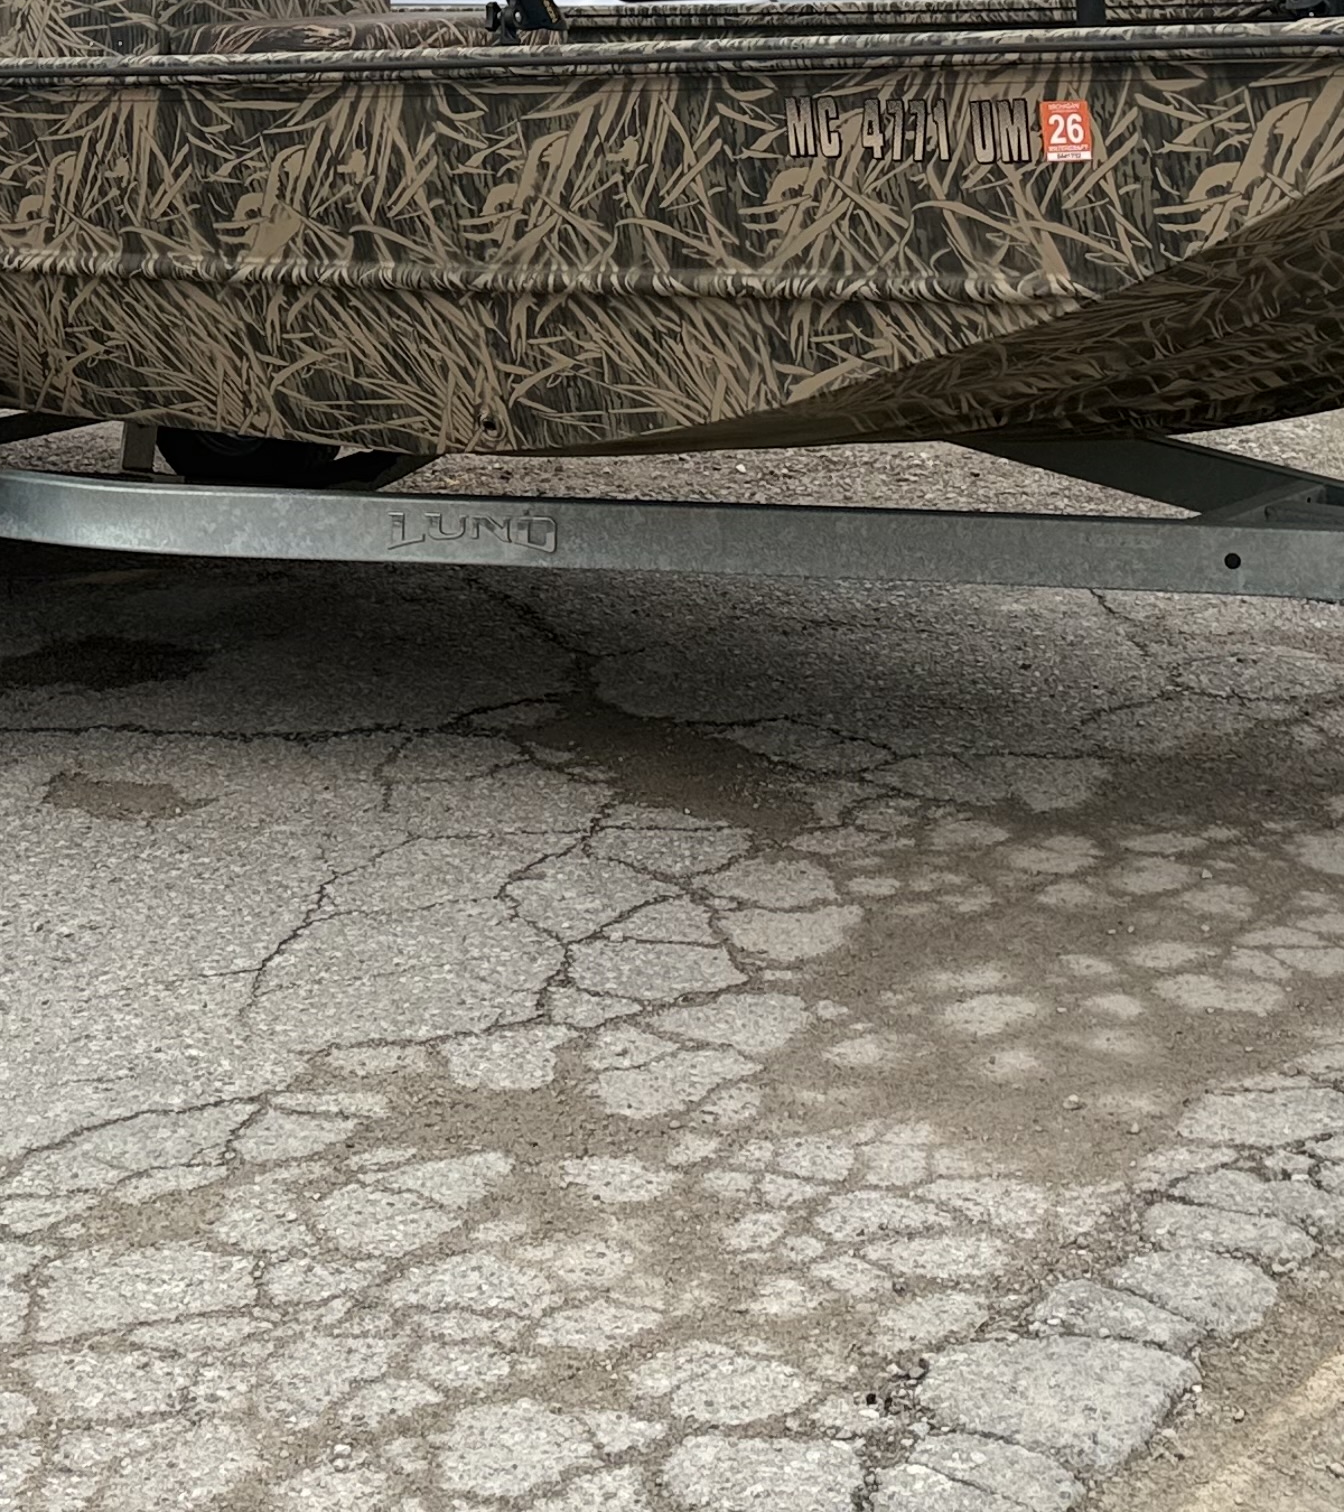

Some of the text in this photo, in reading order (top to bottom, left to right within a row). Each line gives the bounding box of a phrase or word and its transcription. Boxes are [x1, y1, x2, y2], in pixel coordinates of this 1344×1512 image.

[784, 95, 843, 158] MC
[969, 98, 1031, 164] UM
[1048, 113, 1084, 144] 26
[387, 511, 556, 552] LUND
